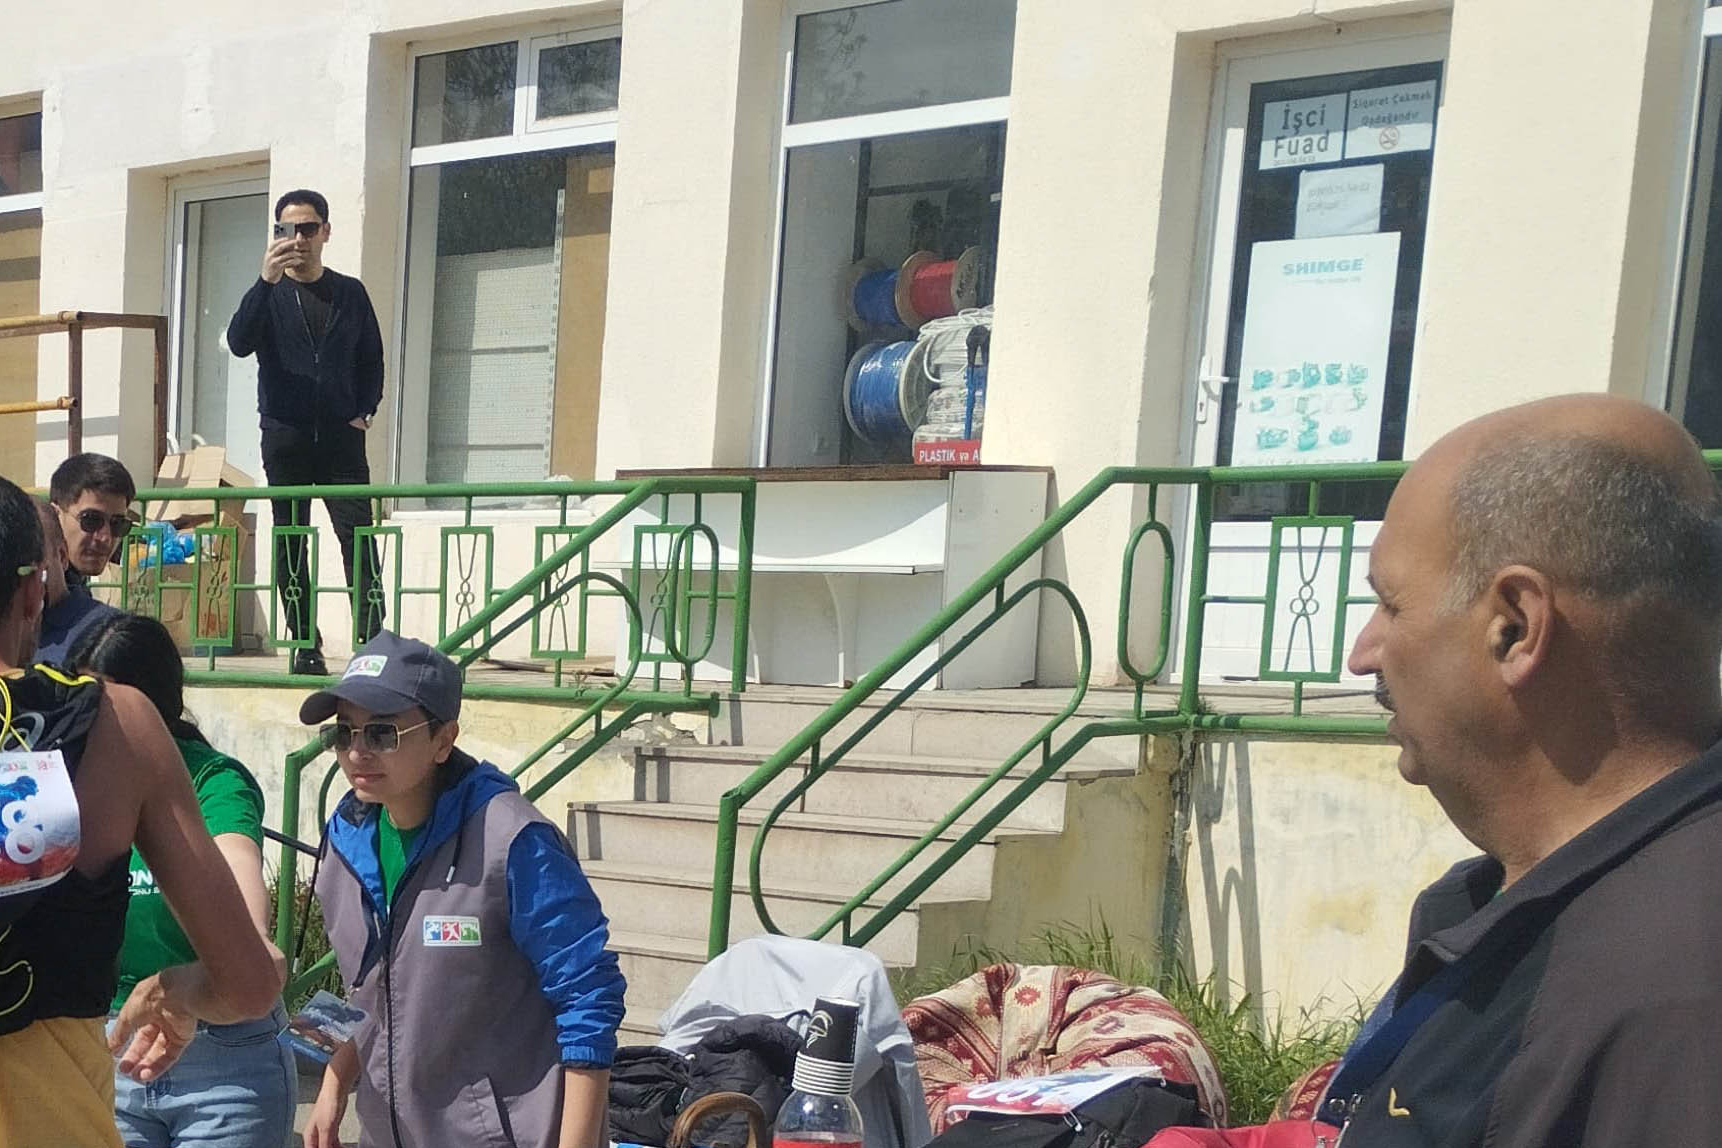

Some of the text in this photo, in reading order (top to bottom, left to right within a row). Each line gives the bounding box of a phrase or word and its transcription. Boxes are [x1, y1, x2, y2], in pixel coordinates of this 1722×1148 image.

[1281, 103, 1327, 135] İşci
[1273, 130, 1330, 158] Fuad
[1283, 257, 1365, 275] SHIMGE
[919, 448, 956, 463] PLASTIK
